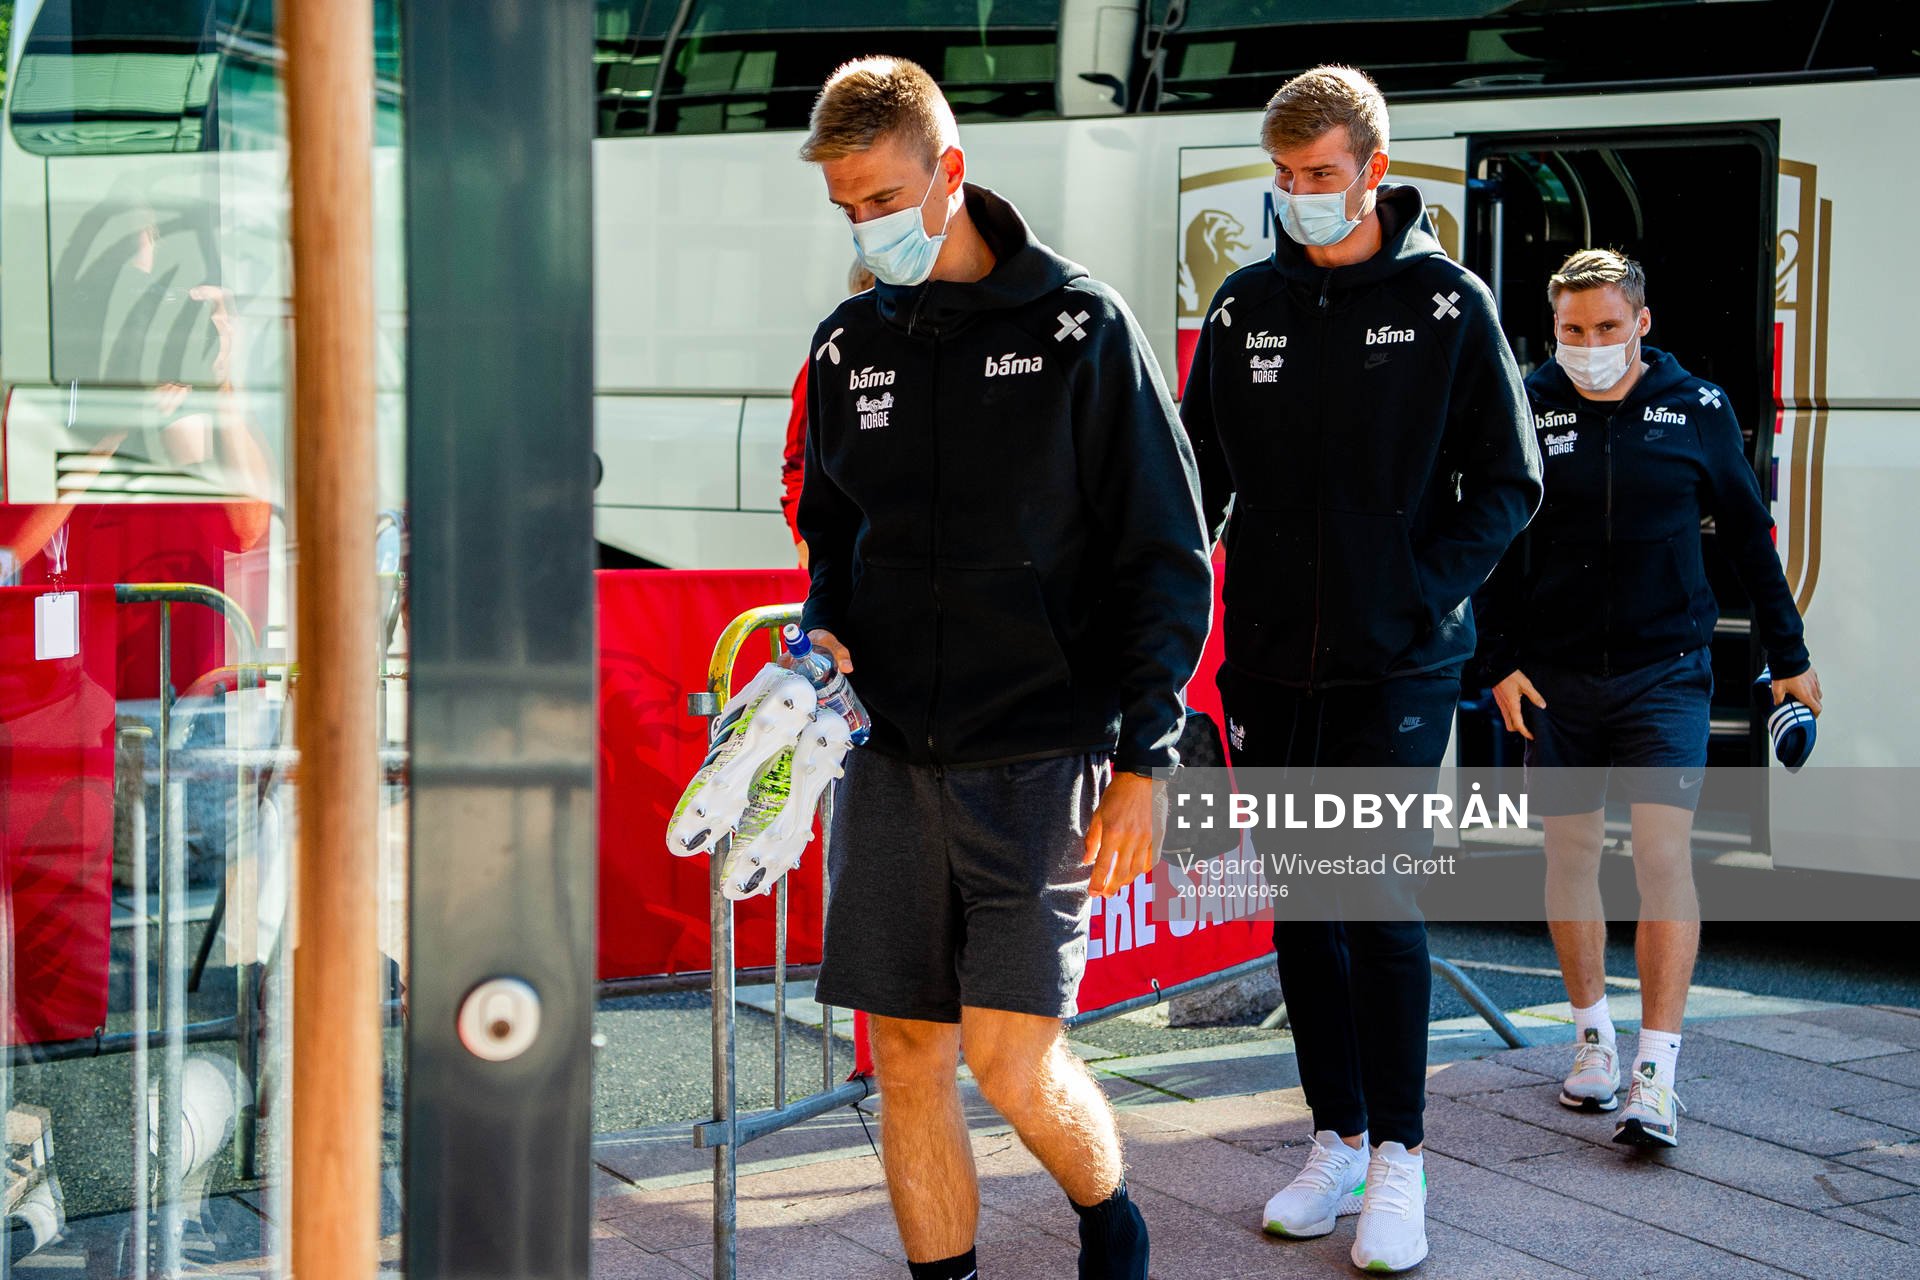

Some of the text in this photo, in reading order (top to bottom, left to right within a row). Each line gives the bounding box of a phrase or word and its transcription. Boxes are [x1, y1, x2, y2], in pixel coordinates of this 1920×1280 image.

[1252, 369, 1279, 384] NORGE
[860, 411, 890, 430] NORGE
[1548, 441, 1575, 457] NORGE
